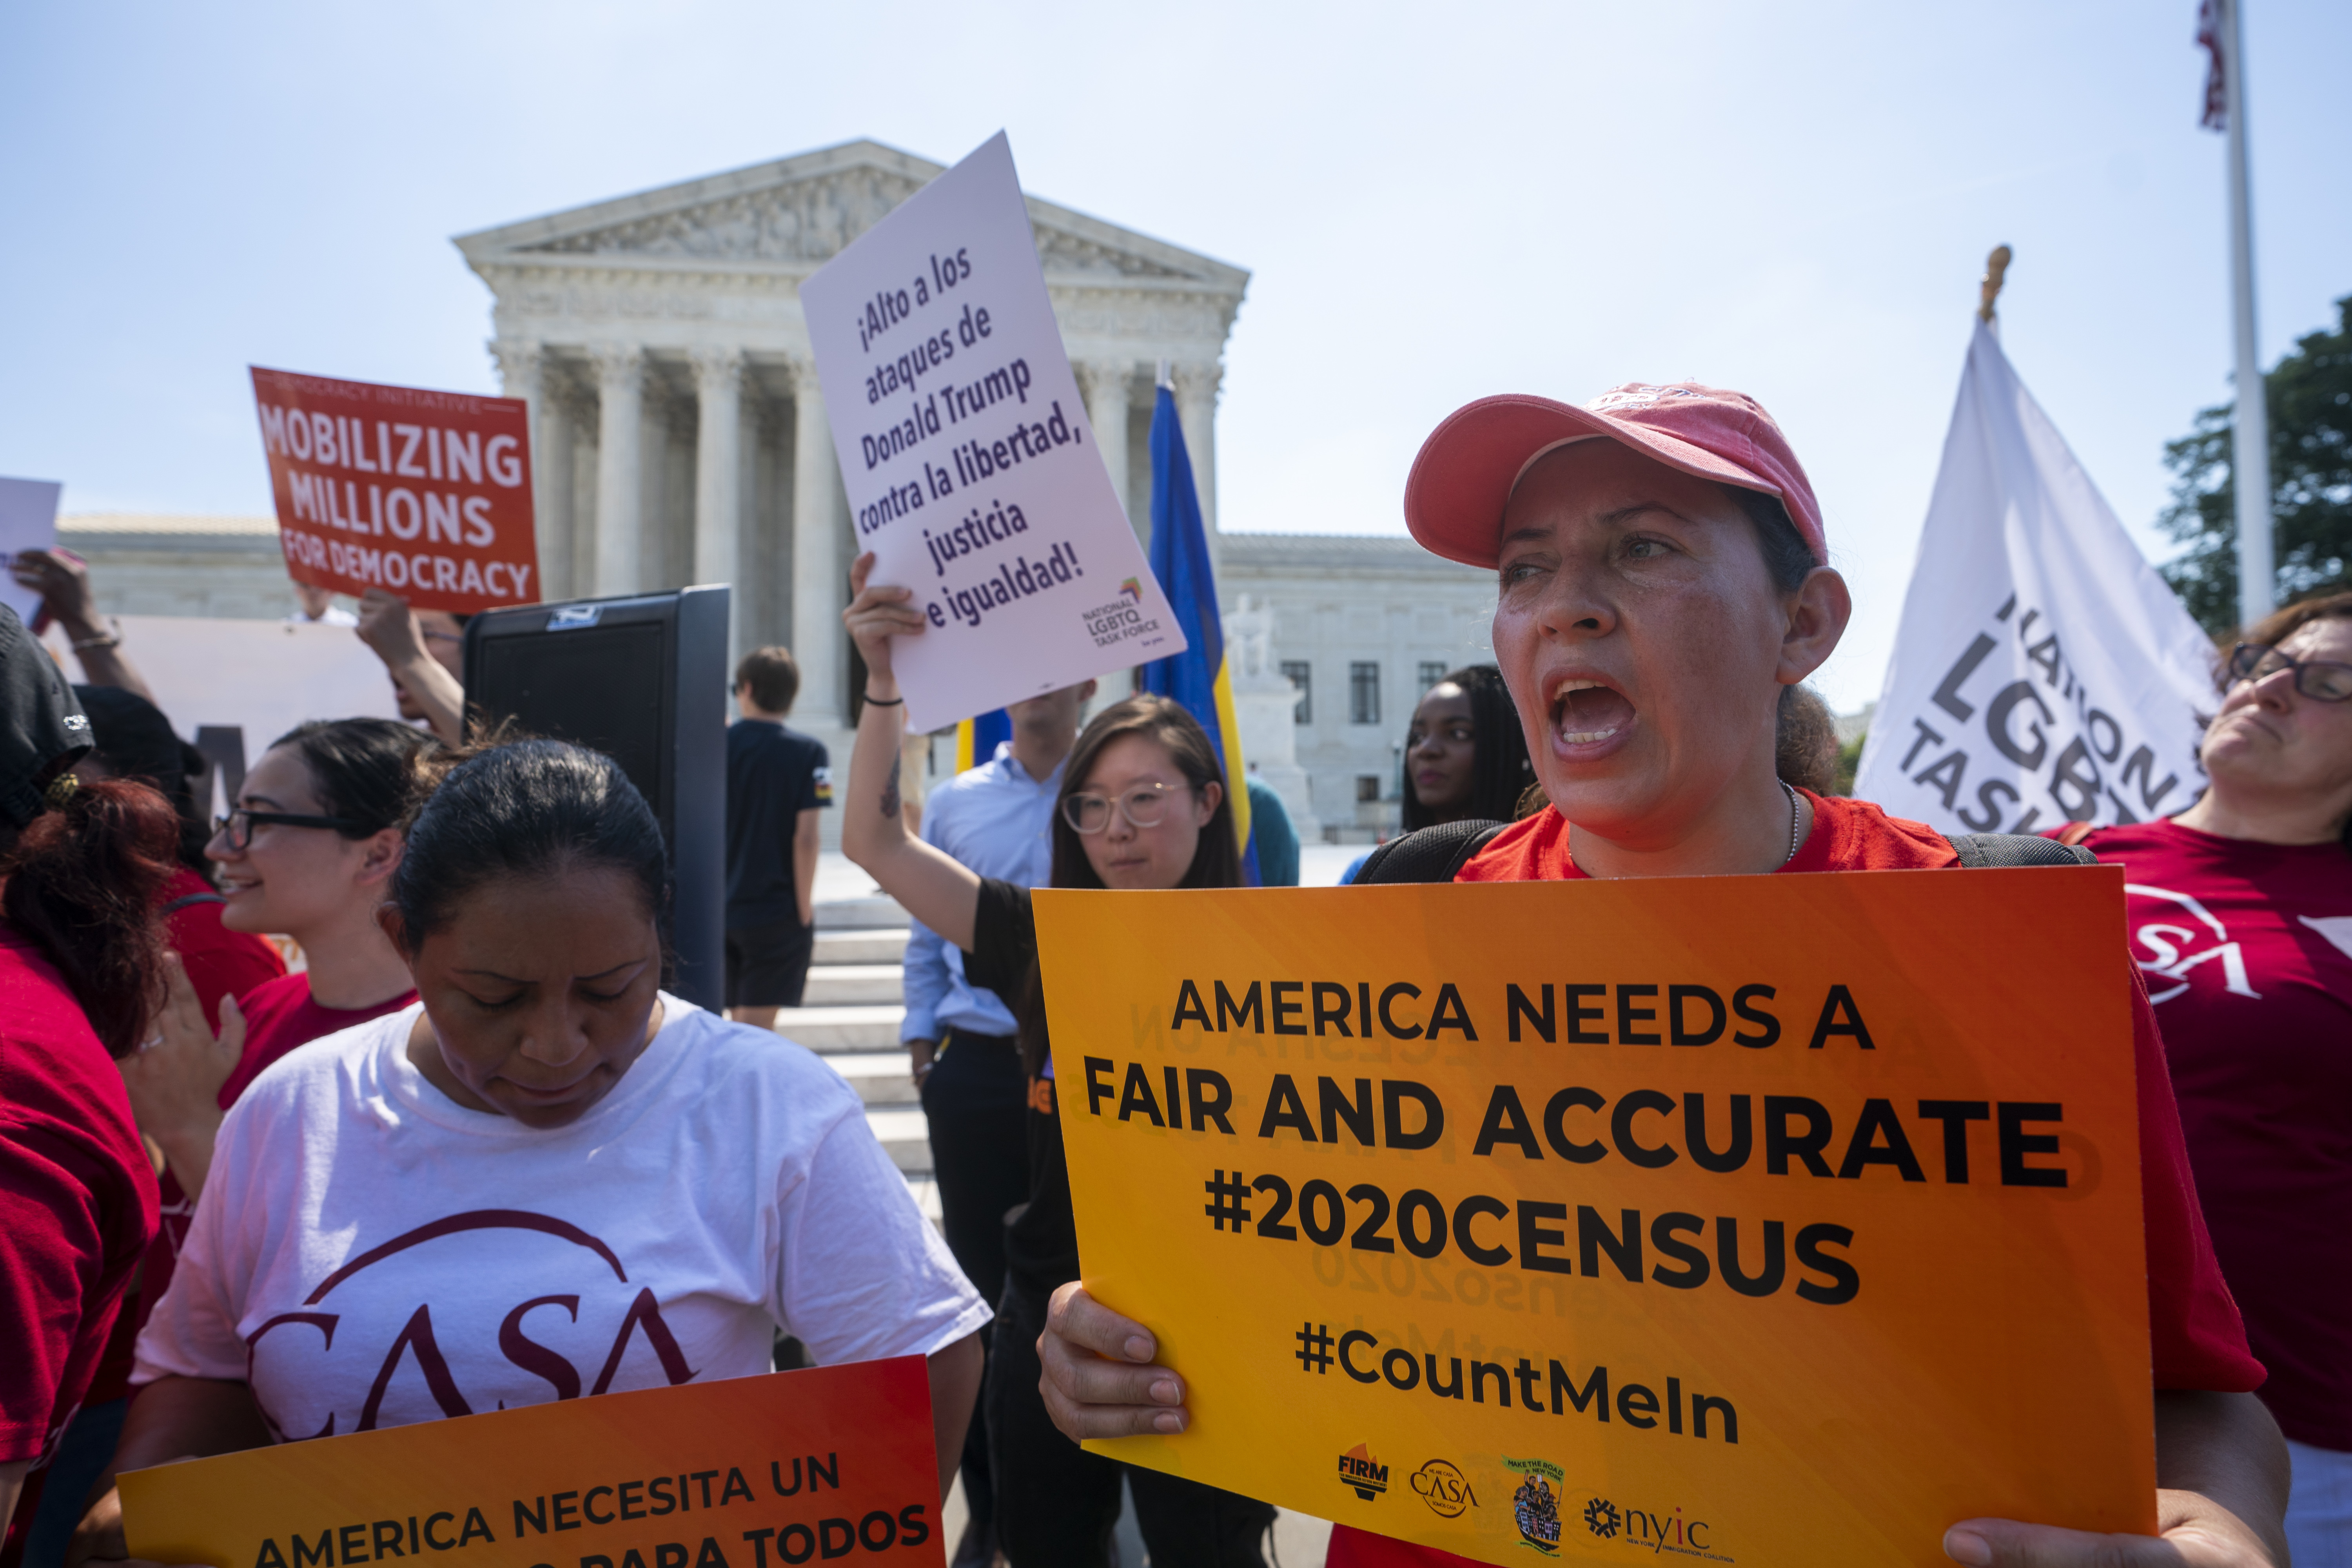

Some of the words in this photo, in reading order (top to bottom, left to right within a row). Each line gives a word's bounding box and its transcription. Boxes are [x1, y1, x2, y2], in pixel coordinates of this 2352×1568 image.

[858, 290, 910, 352] ¡Alto
[915, 276, 929, 307] a
[930, 247, 971, 294] los
[866, 328, 954, 405] ataques
[958, 304, 991, 348] de
[260, 403, 522, 488] MOBILIZING
[861, 394, 941, 471] Donald
[940, 357, 1031, 424] Trump
[859, 479, 924, 535] contra
[924, 463, 953, 501] la
[952, 401, 1082, 487] libertad,
[288, 469, 495, 548] MILLIONS
[924, 499, 1028, 576] justicia
[281, 528, 329, 571] FOR
[328, 539, 530, 599] DEMOCRACY
[926, 600, 946, 628] e
[941, 541, 1083, 627] igualdad!
[1082, 598, 1133, 620] NATIONAL
[1087, 609, 1141, 636] LGBTQ
[1094, 632, 1122, 648] TASK
[1122, 619, 1160, 639] FORCE
[1171, 979, 1479, 1042] AMERICA
[1506, 983, 1782, 1050] NEEDS
[1808, 984, 1876, 1050] A
[1083, 1055, 1236, 1135] FAIR
[1258, 1073, 1445, 1150] AND
[1472, 1084, 2069, 1188] ACCURATE
[1205, 1169, 1860, 1305] #2020CENSUS
[245, 1286, 703, 1446] CASA
[1295, 1321, 1739, 1444] #CountMeIn
[1338, 1455, 1389, 1483] FIRM
[1410, 1472, 1480, 1508] CASA
[1508, 1459, 1527, 1468] MAKE
[1543, 1463, 1563, 1476] ROAD
[1547, 1470, 1562, 1482] YORK
[254, 1506, 496, 1568] AMERICA
[513, 1467, 755, 1538] NECESITA
[771, 1452, 840, 1497] UN
[743, 1504, 929, 1568] TODOS
[1432, 1501, 1446, 1509] SOMOS
[1626, 1506, 1710, 1554] nyic
[1640, 1540, 1655, 1548] YORK
[1662, 1544, 1701, 1557] IMMIGRATION
[1704, 1553, 1735, 1564] COALITION
